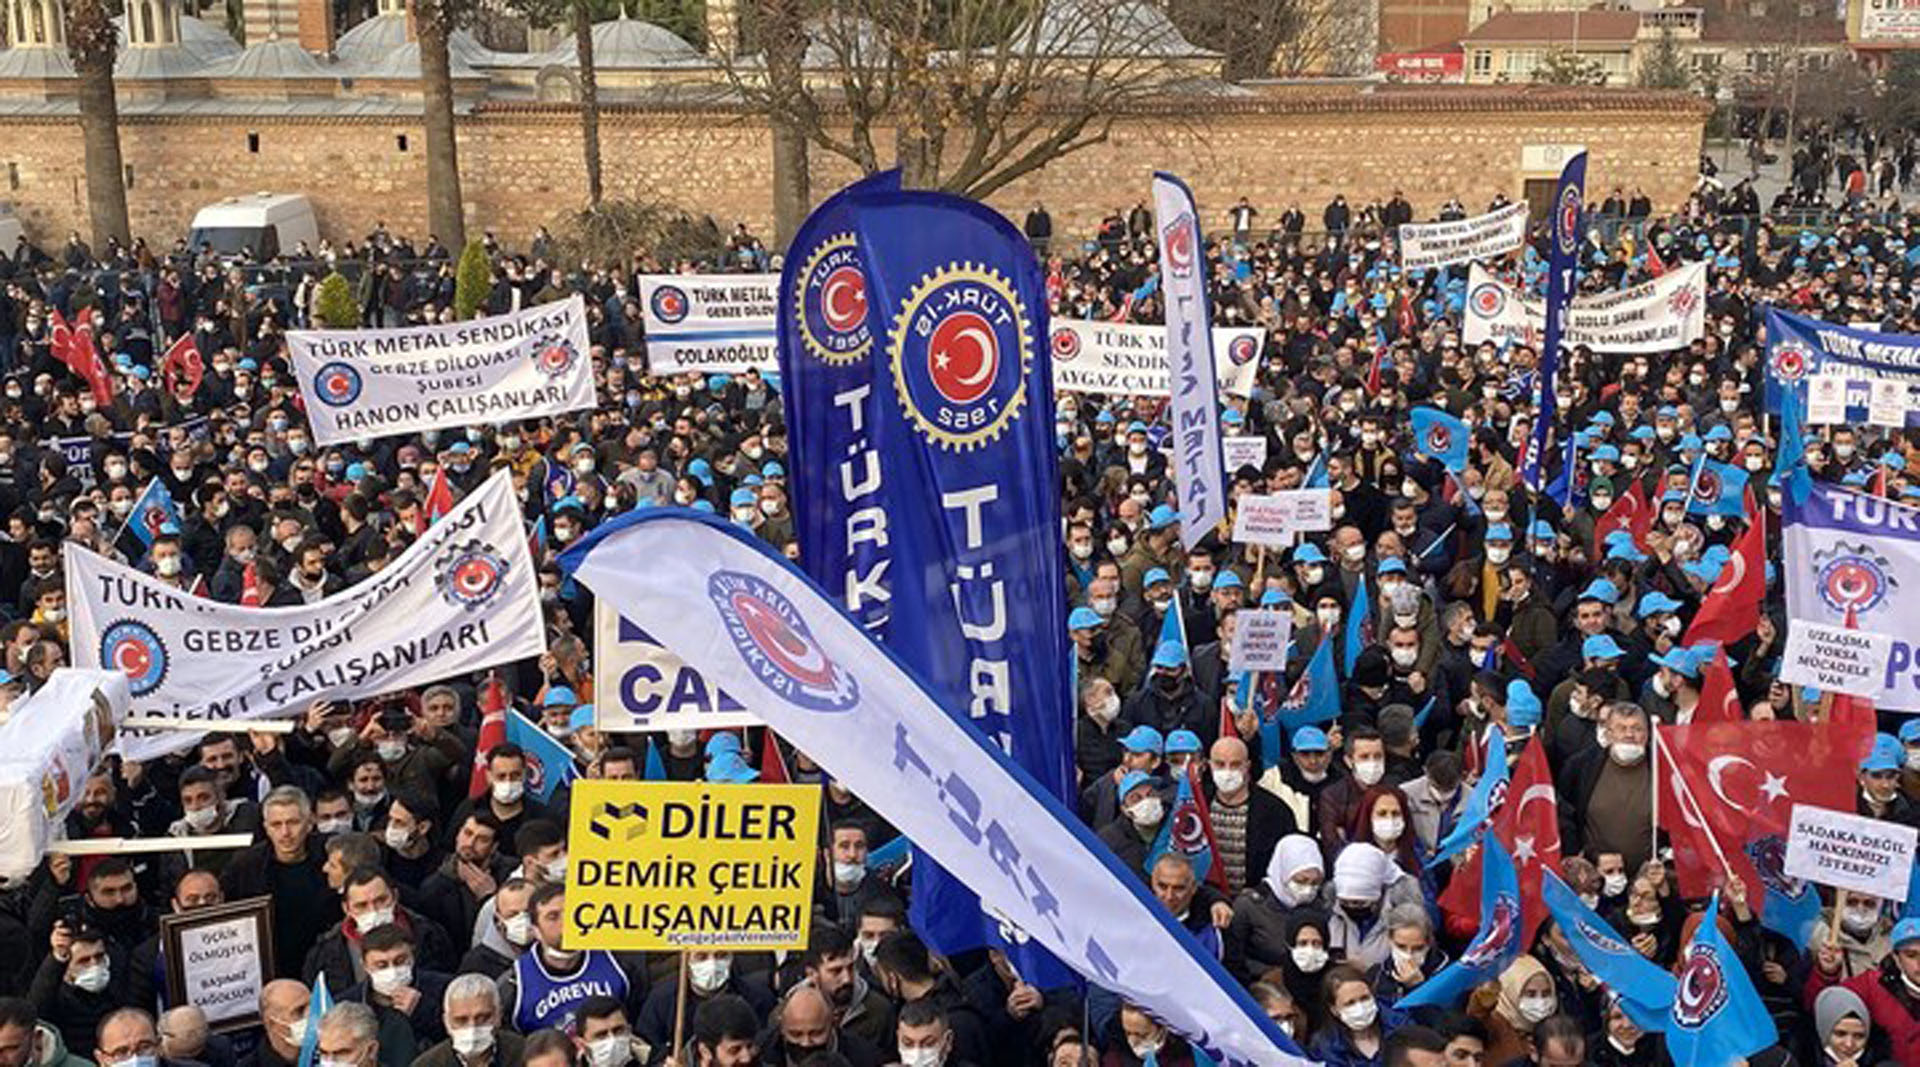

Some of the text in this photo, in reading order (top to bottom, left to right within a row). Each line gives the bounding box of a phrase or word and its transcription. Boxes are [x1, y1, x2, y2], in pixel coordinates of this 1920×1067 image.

[692, 285, 729, 302] TÜRK
[731, 286, 772, 302] METAL
[308, 310, 573, 358] TÜRK METAL SENDİKASI
[1093, 329, 1143, 344] TÜRK
[1816, 329, 1864, 360] TÜRK
[436, 348, 522, 373] DİLOVASI
[674, 344, 769, 366] ÇOLAKOĞLU
[416, 373, 482, 395] ŞUBESİ
[1057, 370, 1119, 388] AYGAZ
[335, 385, 568, 431] HANON ÇALIŞANLARI
[183, 628, 281, 653] GEBZE
[1807, 628, 1872, 650] UZLAŞMA
[265, 619, 491, 706] ÇALIŞANLARI
[1814, 643, 1859, 662] YOKSA
[1797, 655, 1871, 678] MÜCADELE
[1885, 641, 1920, 690] P
[1818, 671, 1845, 687] VAR
[661, 793, 797, 840] DİLER
[1796, 823, 1908, 855] SADAKA DEĞİL
[1808, 840, 1891, 867] HAKKIMIZI
[577, 854, 802, 894] DEMİR ÇELİK
[1818, 855, 1877, 879] İSTERİZ
[573, 902, 801, 937] ÇALIŞANLARI
[188, 942, 254, 964] ÖLMÜŞTÜR
